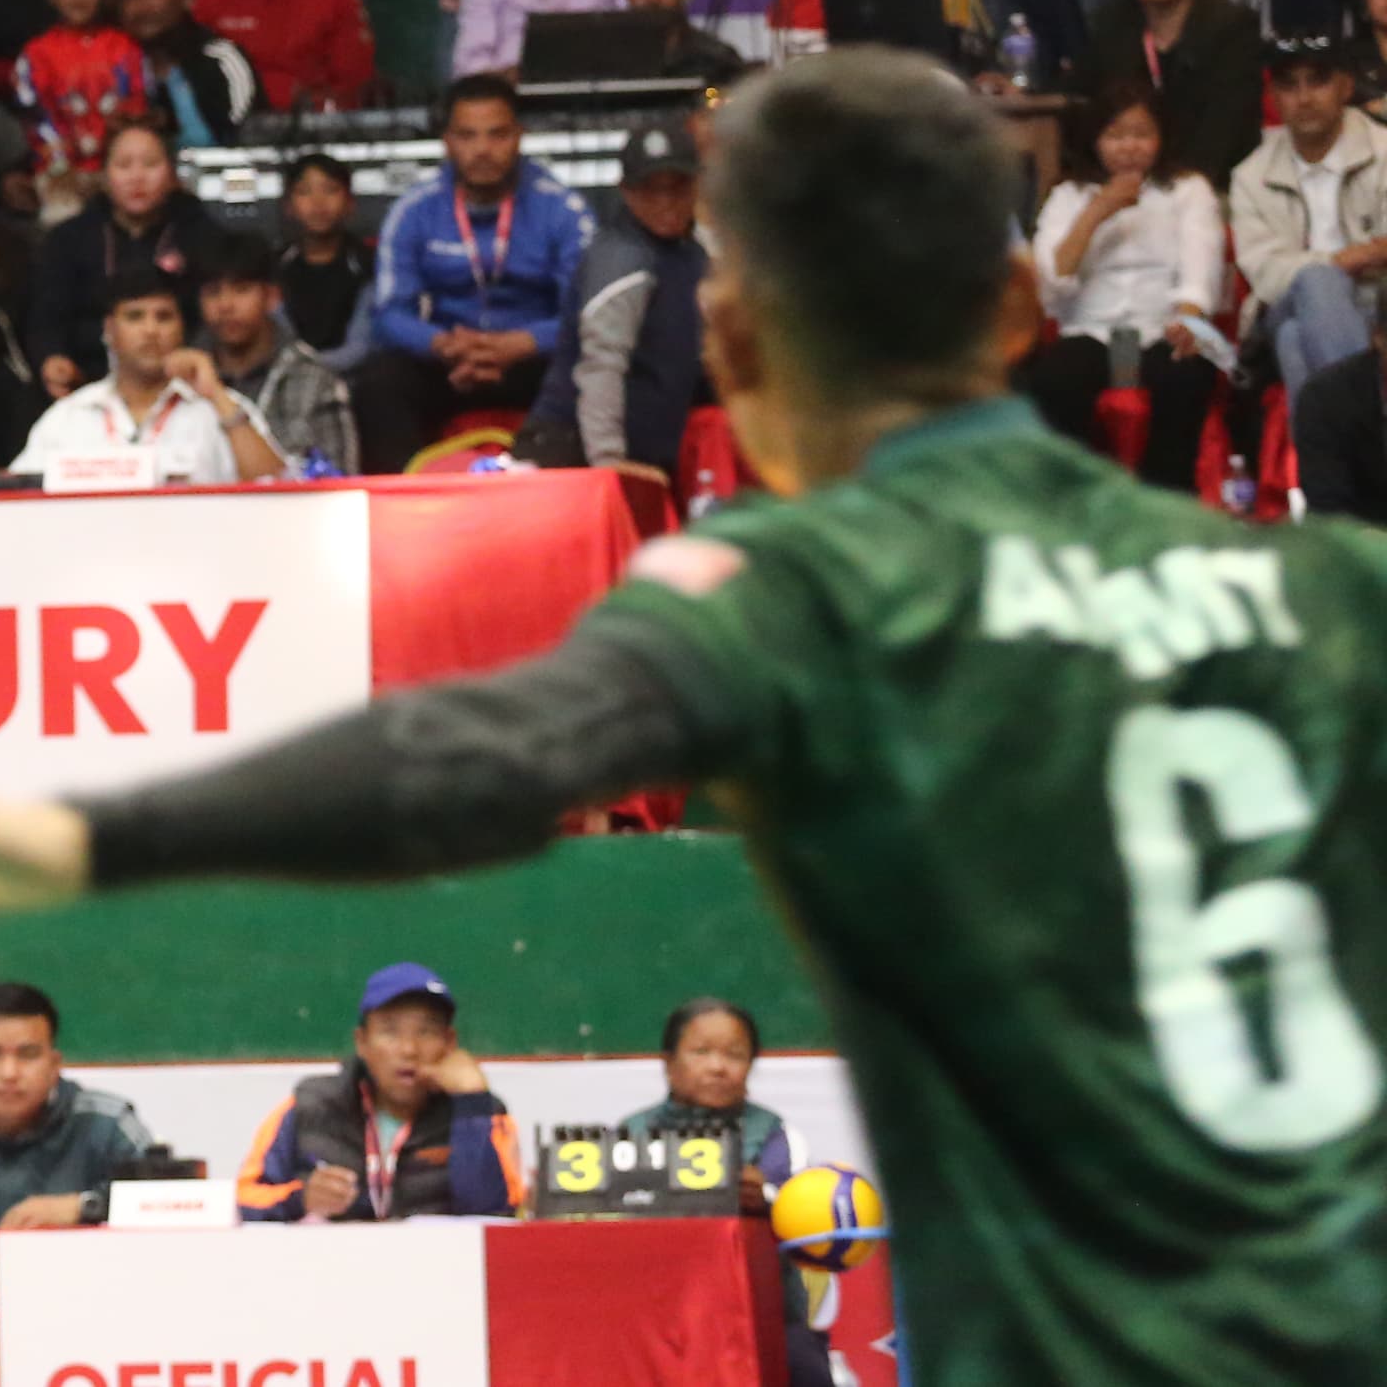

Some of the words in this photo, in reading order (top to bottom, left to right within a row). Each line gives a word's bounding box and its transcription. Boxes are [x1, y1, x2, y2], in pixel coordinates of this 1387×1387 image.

[1107, 702, 1382, 1154] 6
[555, 1140, 605, 1193] 3
[612, 1139, 638, 1172] 0
[647, 1139, 667, 1171] 1
[676, 1137, 726, 1191] 3
